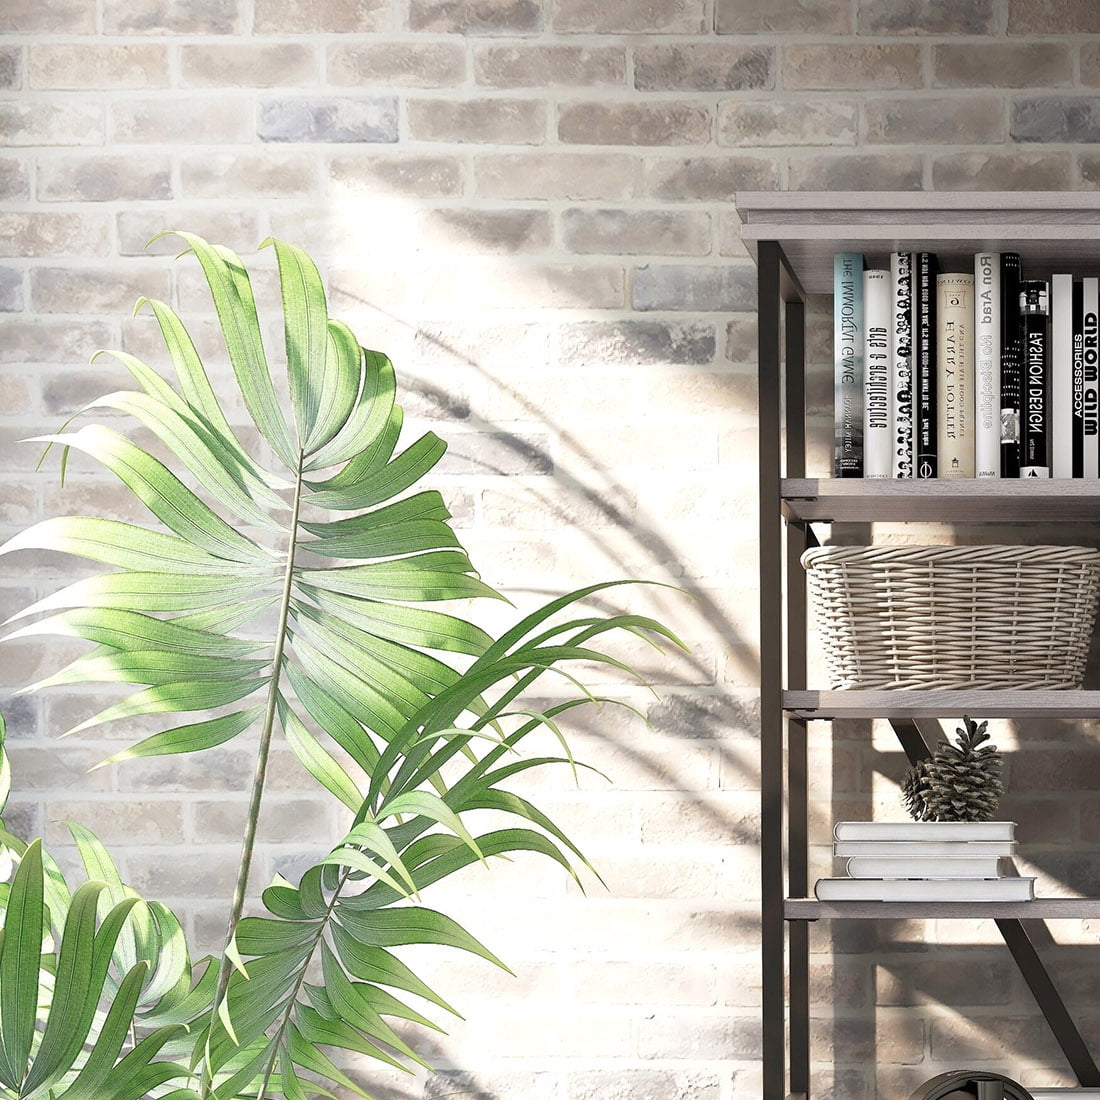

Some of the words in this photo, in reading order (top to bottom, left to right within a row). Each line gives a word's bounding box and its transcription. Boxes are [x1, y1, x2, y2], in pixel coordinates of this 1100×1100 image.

[1074, 334, 1082, 418] ACCESSORIES
[1085, 313, 1097, 381] WORLD
[1085, 388, 1097, 435] WILD
